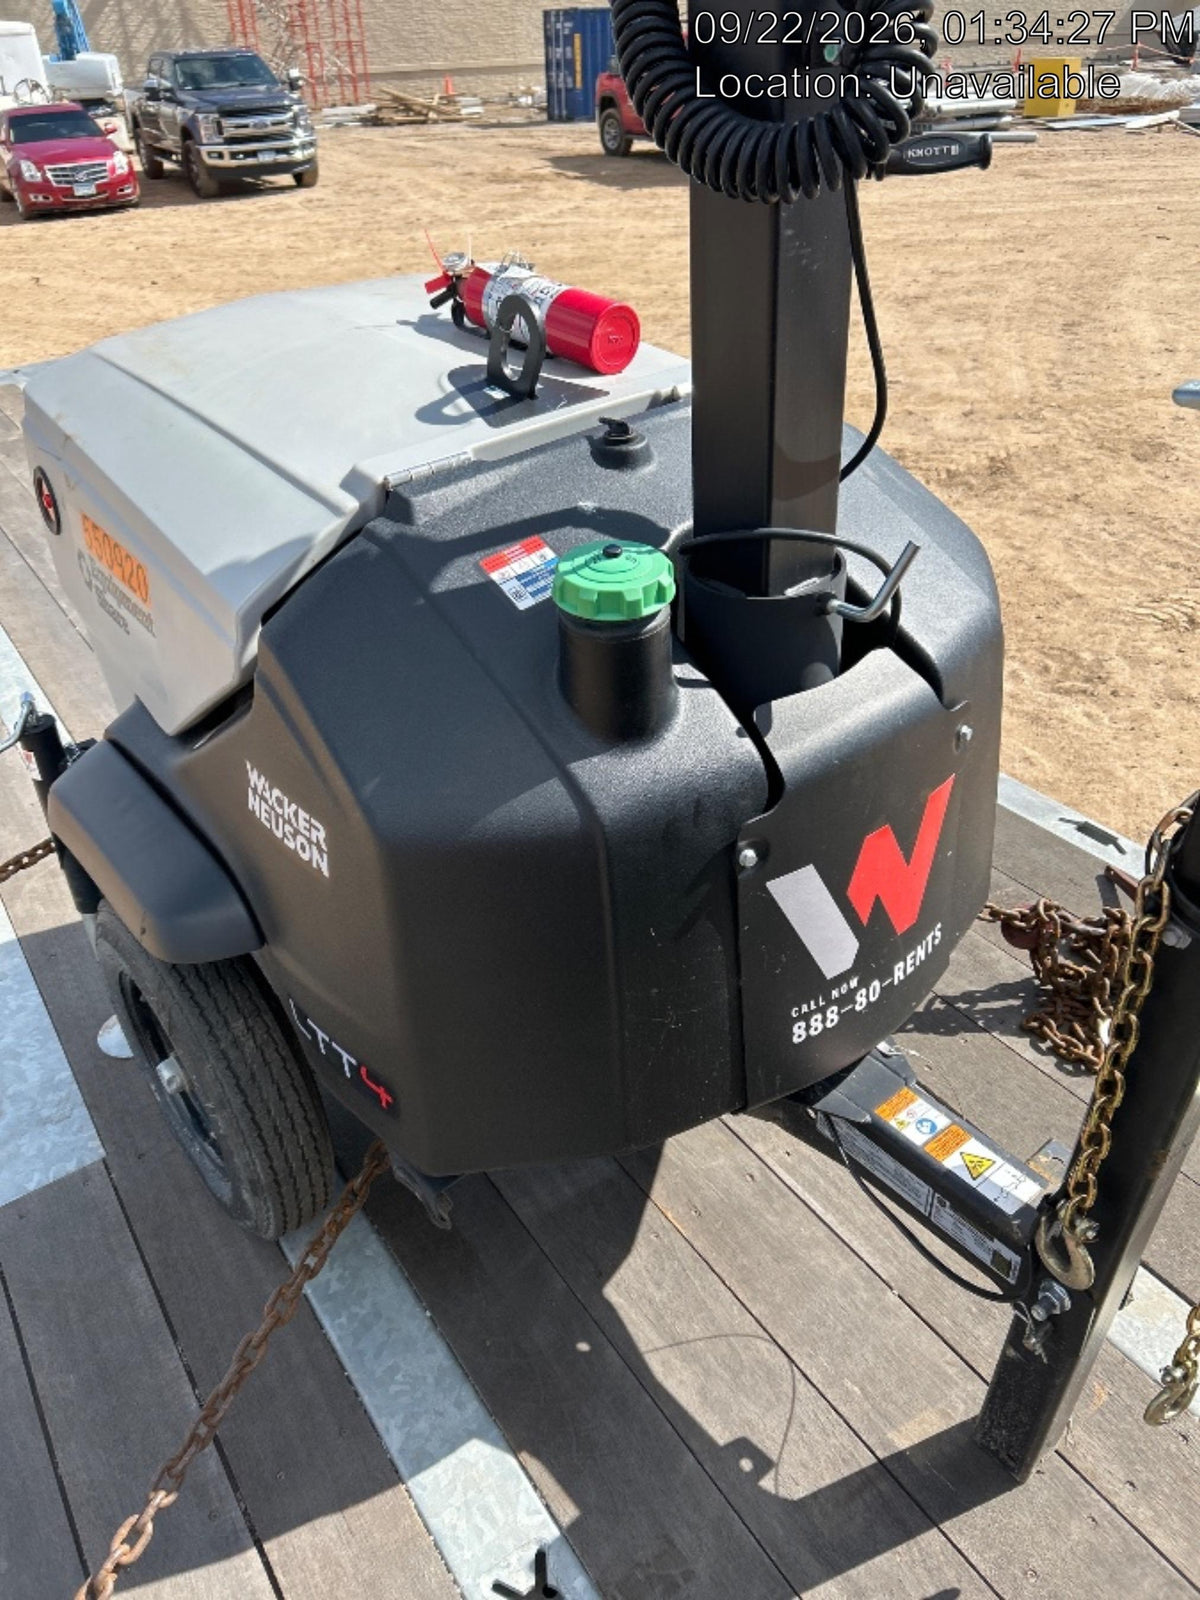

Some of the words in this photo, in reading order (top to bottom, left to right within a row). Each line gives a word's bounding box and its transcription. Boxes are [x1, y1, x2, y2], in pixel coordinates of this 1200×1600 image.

[245, 760, 328, 852] WACKER
[247, 786, 330, 878] NEUSON
[791, 995, 826, 1018] CALL
[831, 975, 859, 1000] NOW
[792, 922, 942, 1044] 888-80-RENTS
